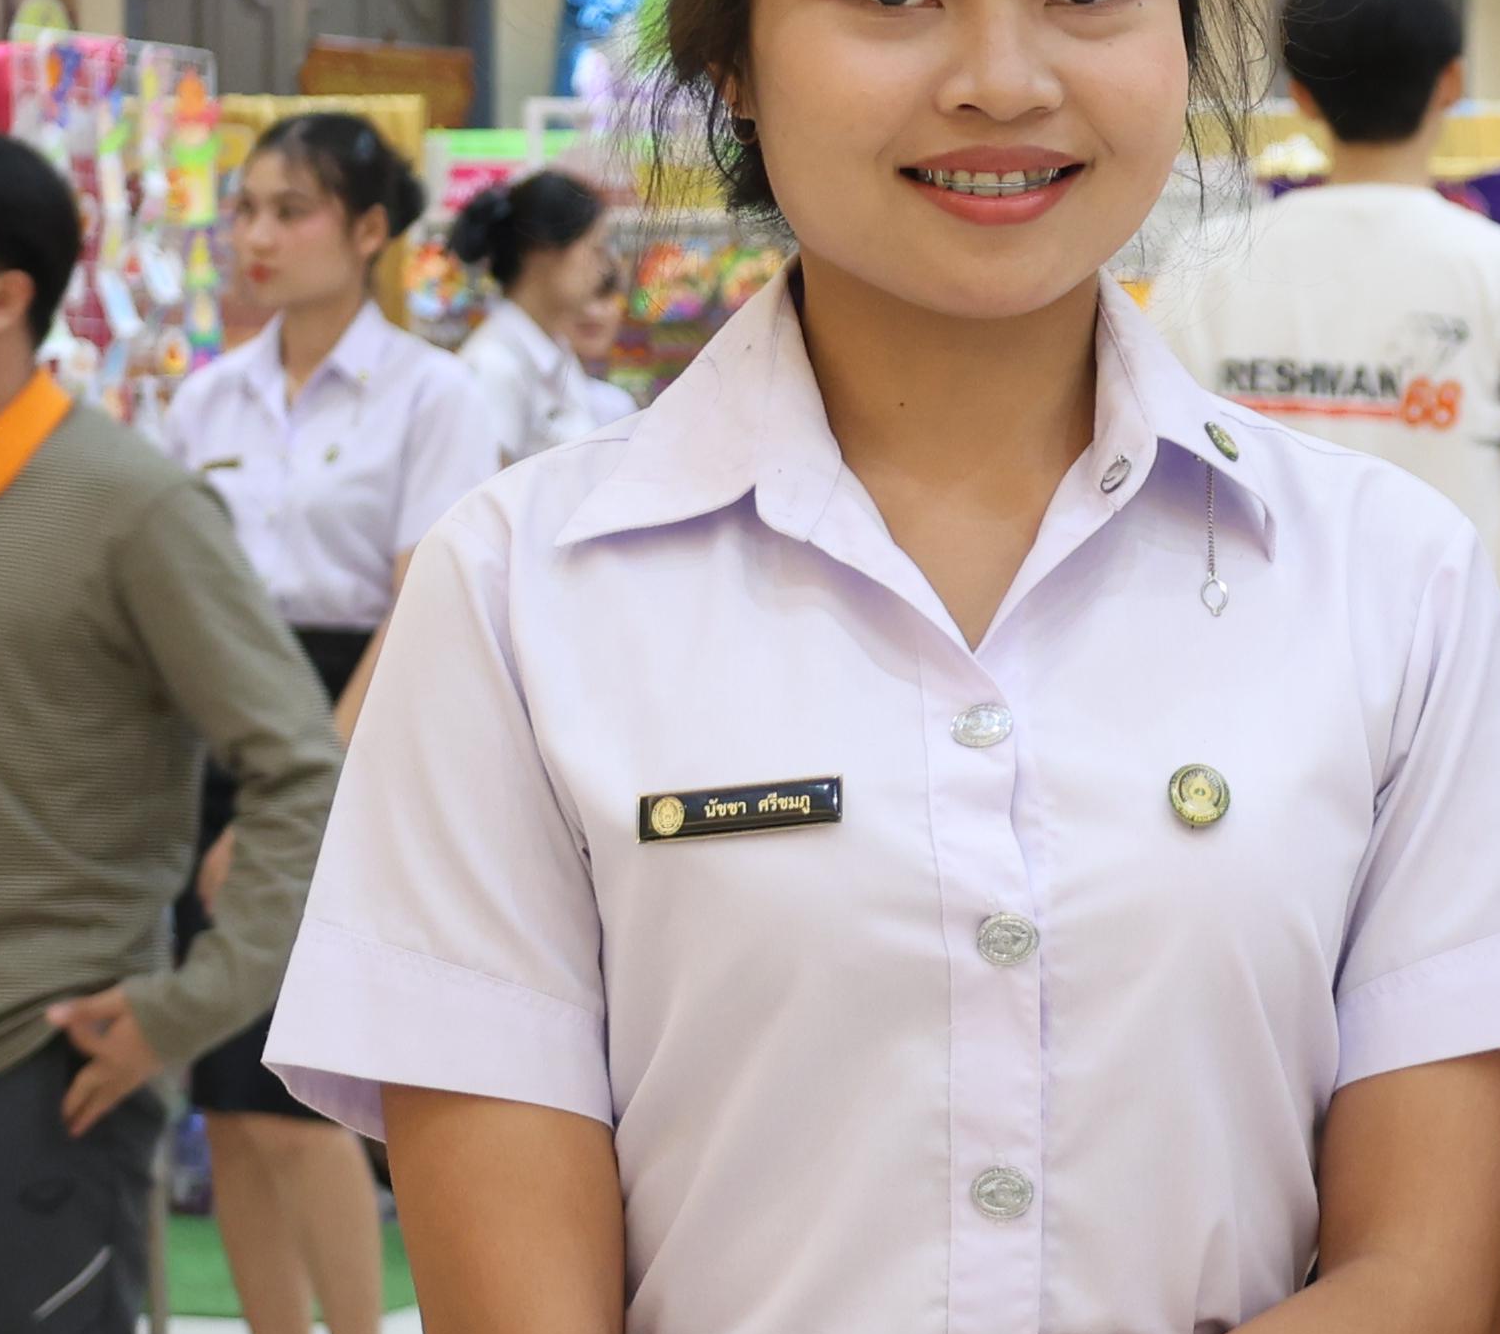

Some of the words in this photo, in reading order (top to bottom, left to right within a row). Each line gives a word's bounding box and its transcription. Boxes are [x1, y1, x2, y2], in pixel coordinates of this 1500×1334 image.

[704, 797, 747, 818] นัชชา
[758, 791, 810, 815] ศรีชมภู
